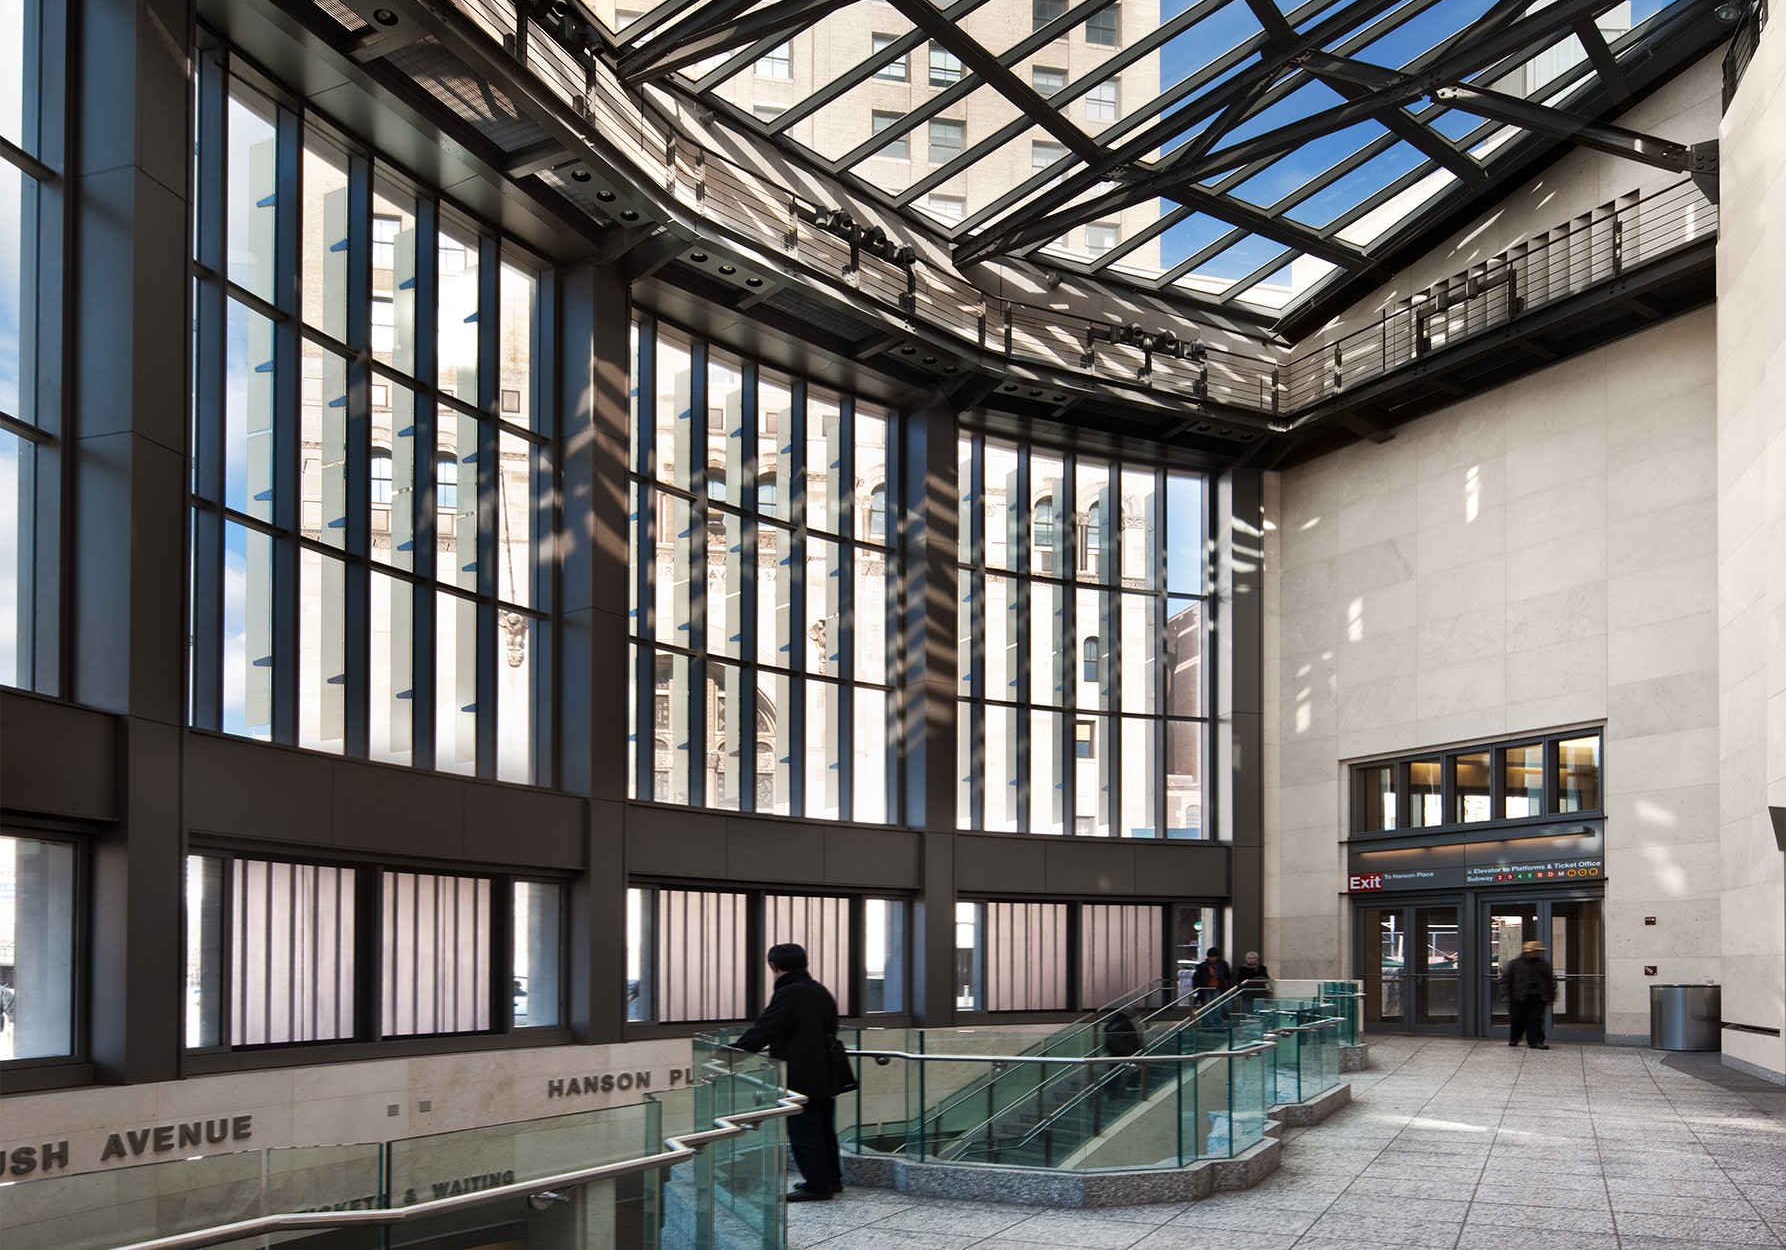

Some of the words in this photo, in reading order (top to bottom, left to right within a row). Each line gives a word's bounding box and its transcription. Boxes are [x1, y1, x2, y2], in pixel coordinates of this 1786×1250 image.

[1350, 876, 1381, 889] Exit
[548, 1071, 651, 1097] HANSON
[0, 1141, 69, 1177] SH
[101, 1115, 252, 1161] AVENUE
[404, 1188, 417, 1202] &
[431, 1170, 515, 1197] WAITING
